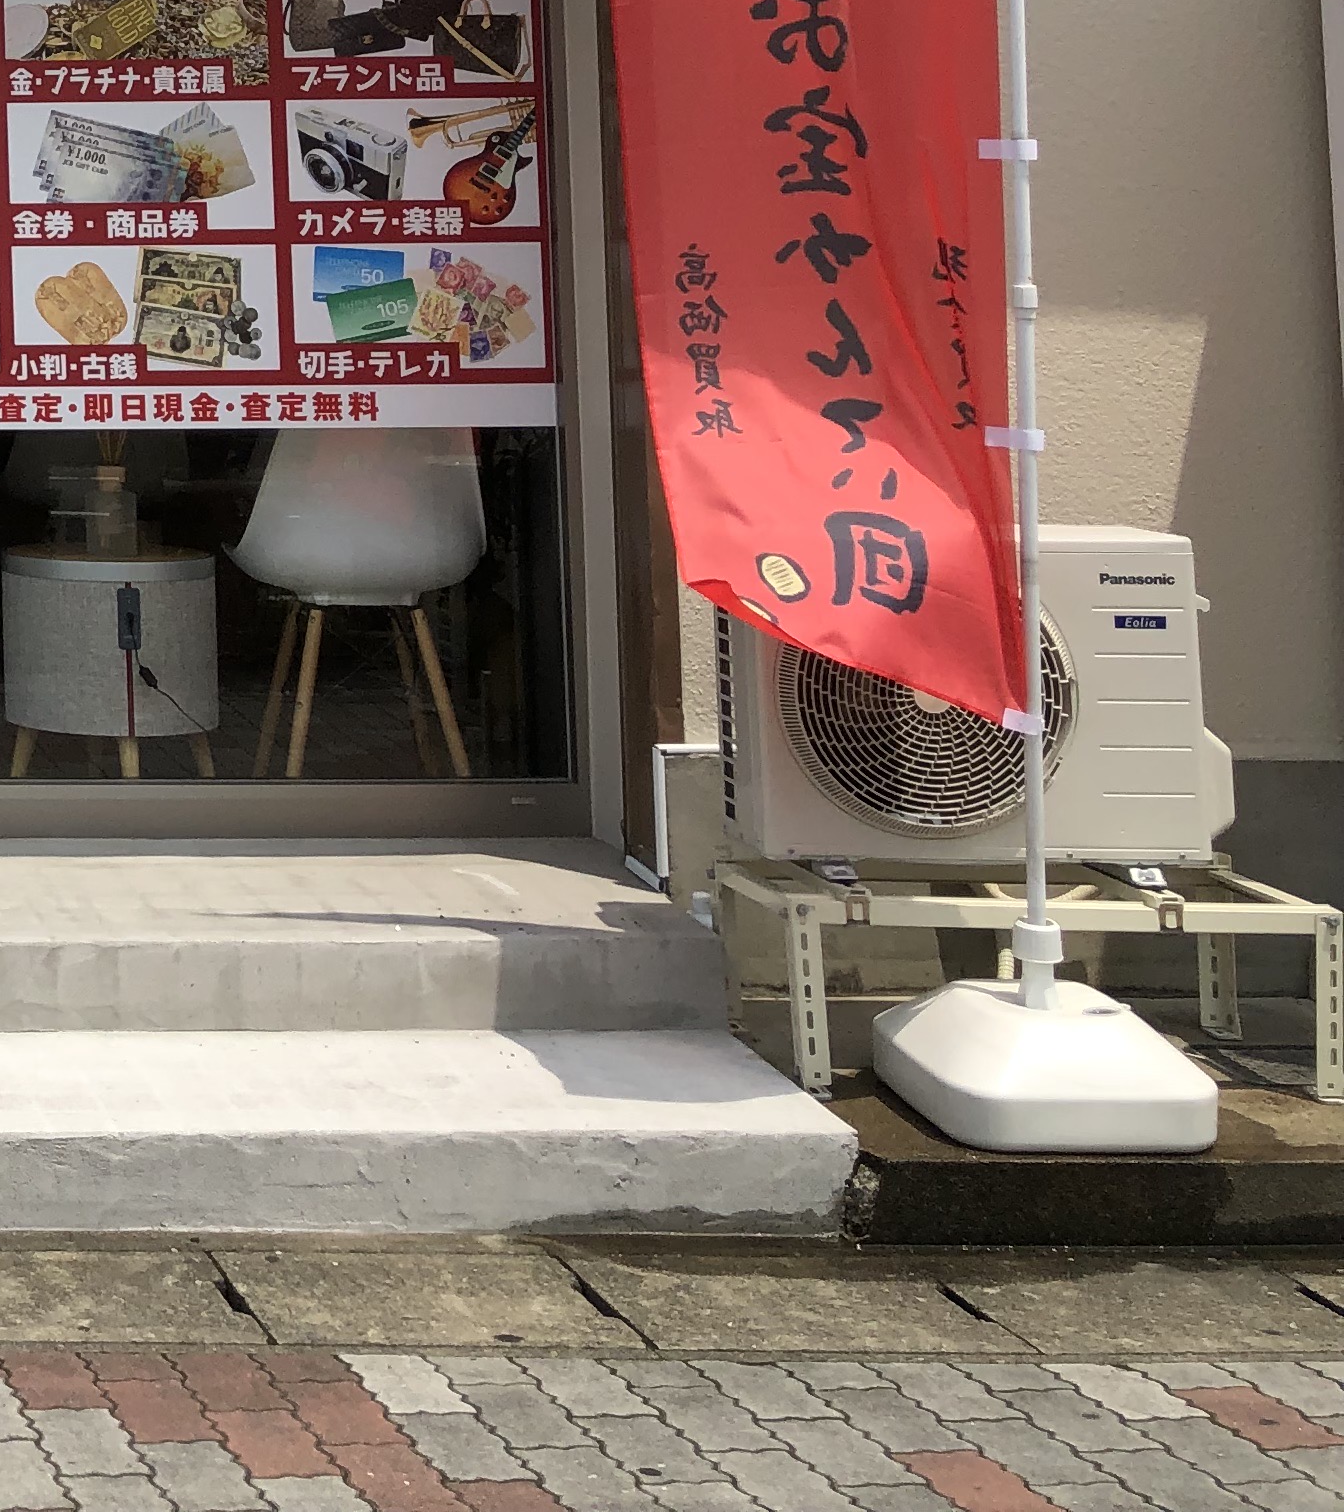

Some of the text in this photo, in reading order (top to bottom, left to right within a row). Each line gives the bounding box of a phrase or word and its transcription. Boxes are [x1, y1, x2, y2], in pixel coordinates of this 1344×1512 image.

[107, 7, 139, 44] GOLD
[10, 65, 225, 97] 金・プラチナ・貴金属
[292, 63, 446, 92] ブランド品
[13, 210, 199, 240] 金券・商品券
[298, 207, 464, 237] カメラ・楽器
[361, 269, 384, 284] 50
[377, 299, 408, 317] 105
[11, 353, 138, 382] 小判・古銭
[298, 350, 451, 379] 切手・テレカ
[1099, 573, 1175, 585] Panasonic
[1125, 616, 1157, 628] Eolia
